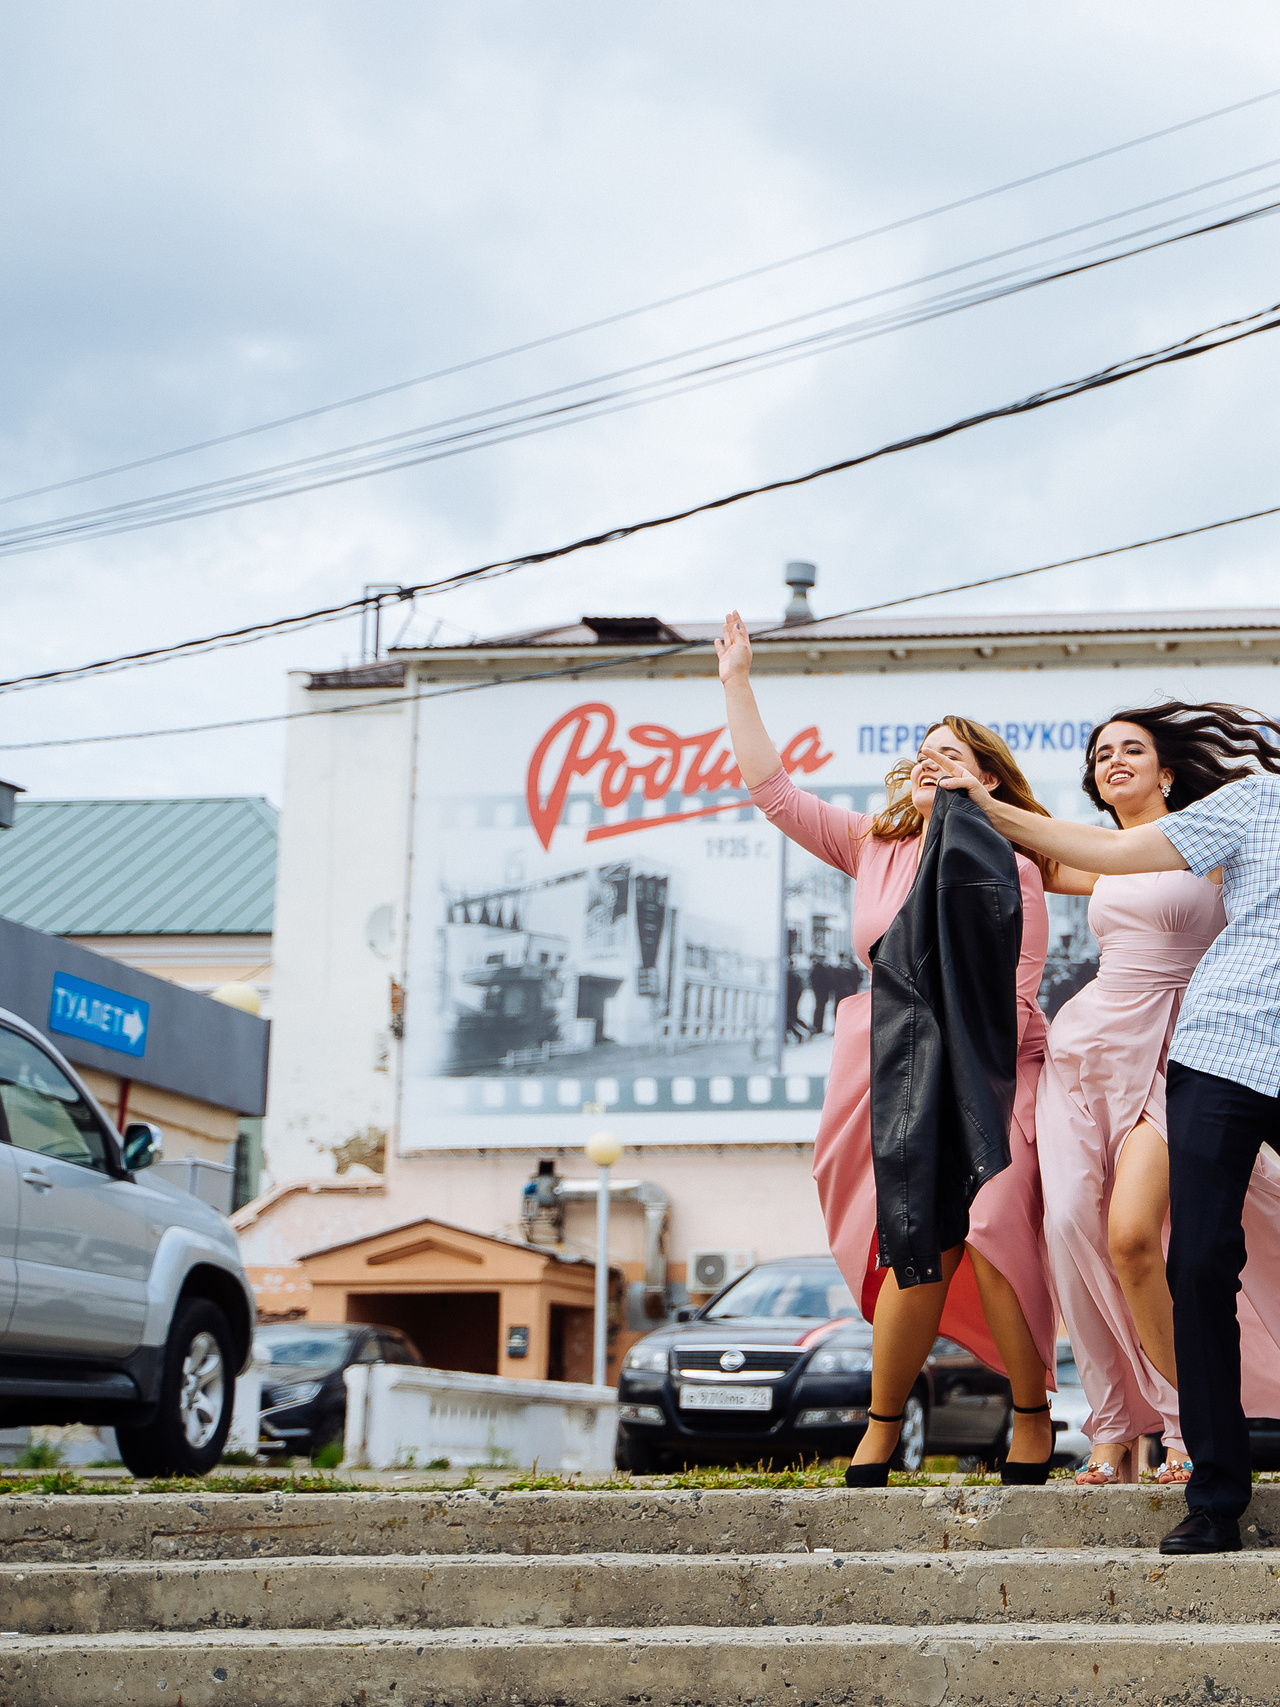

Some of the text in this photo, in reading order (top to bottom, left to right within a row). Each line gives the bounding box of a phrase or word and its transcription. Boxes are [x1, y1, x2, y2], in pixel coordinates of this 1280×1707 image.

[857, 723, 927, 754] ПЕРВ
[527, 701, 834, 851] Родиа
[55, 986, 124, 1035] ТУАЛЕТ
